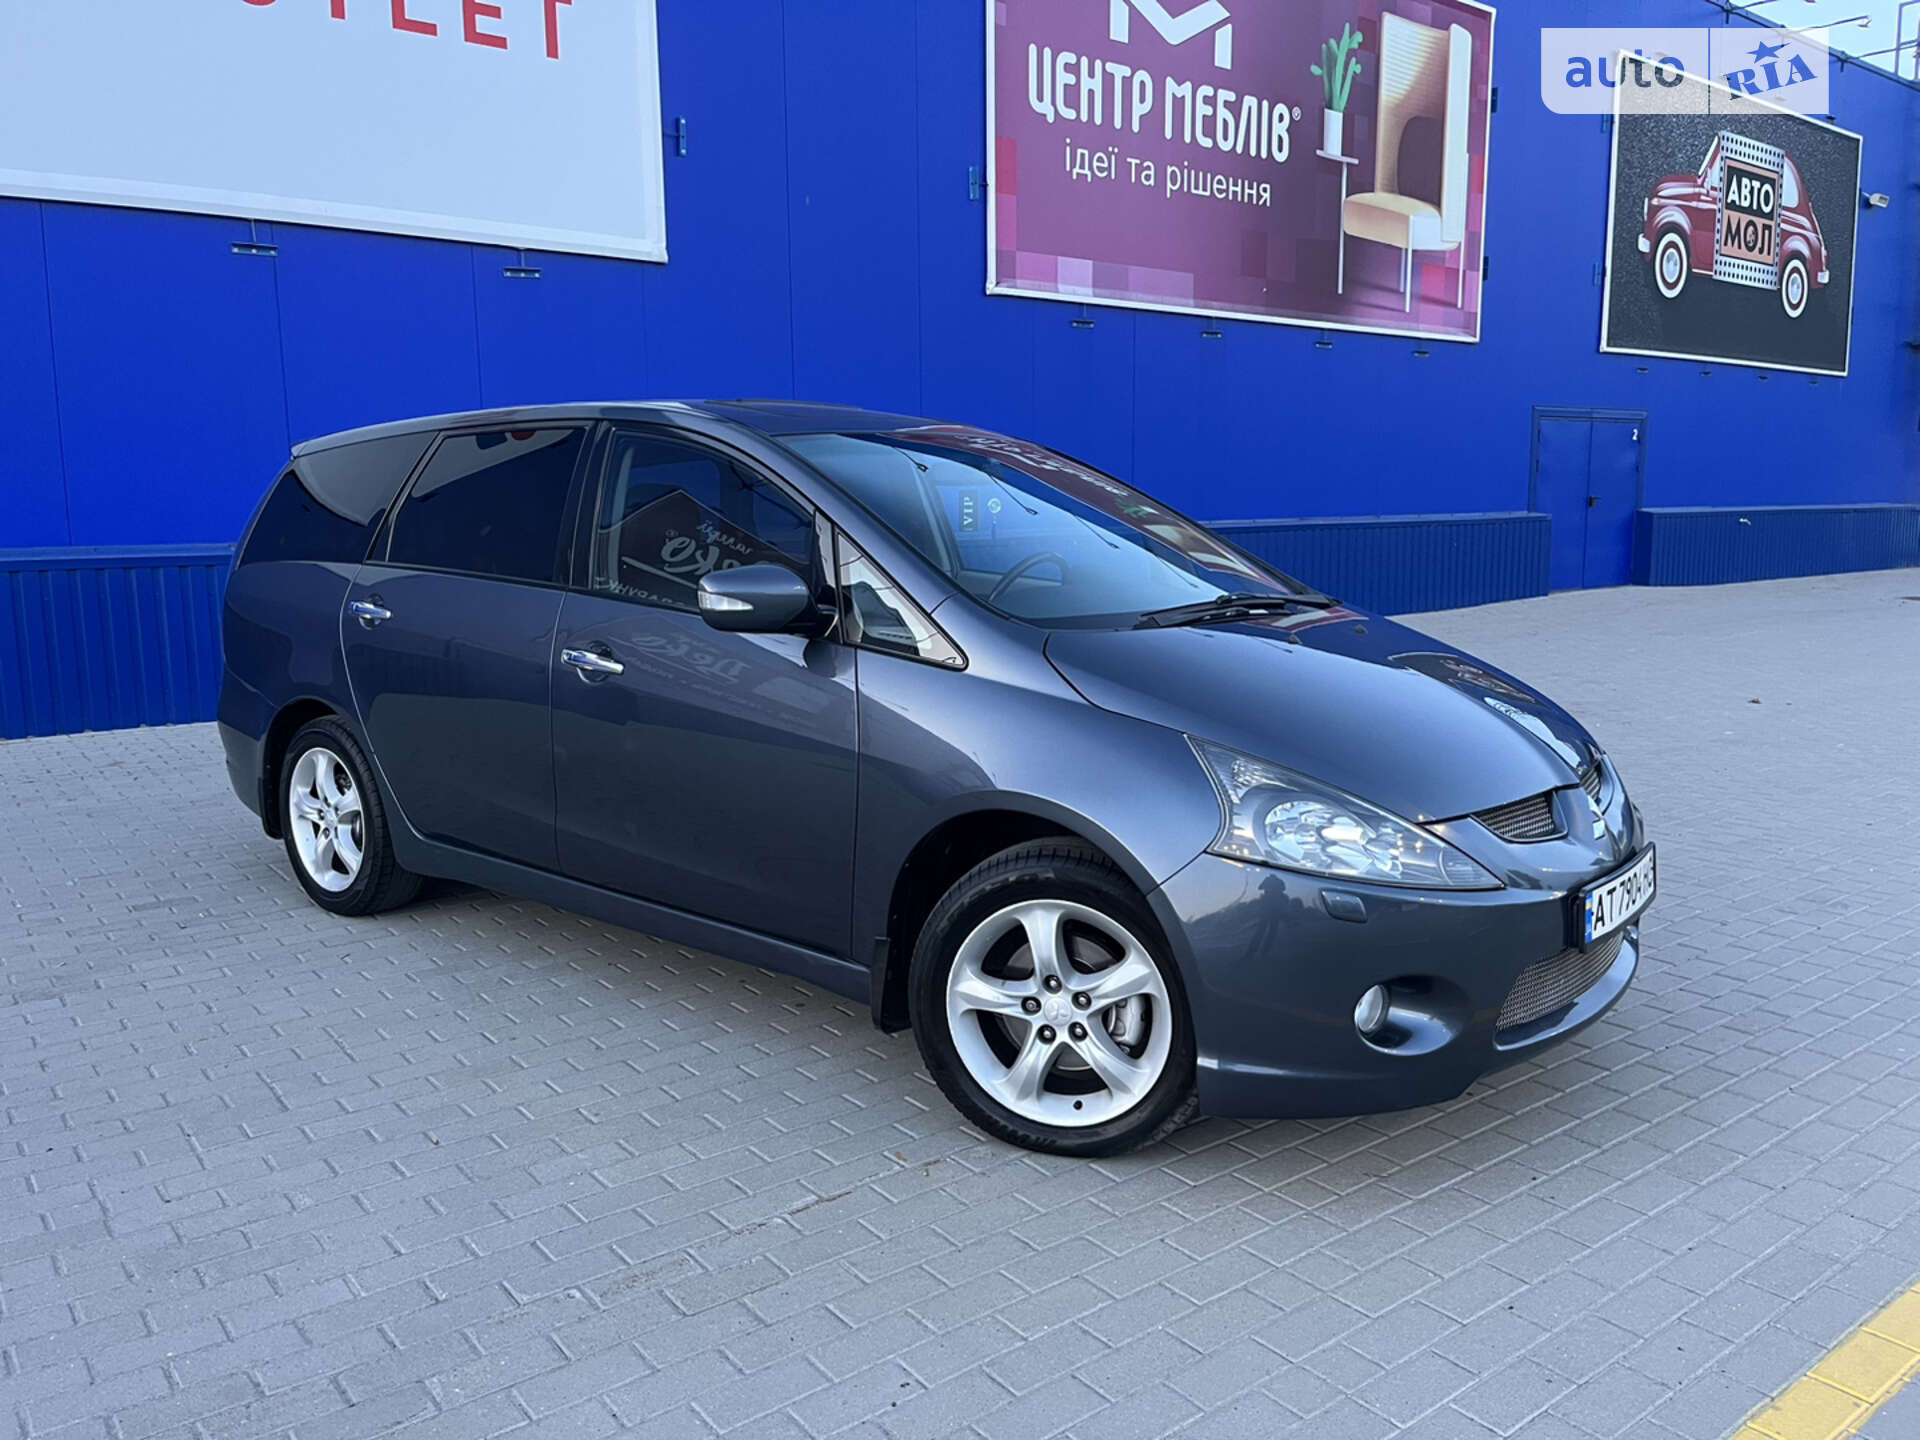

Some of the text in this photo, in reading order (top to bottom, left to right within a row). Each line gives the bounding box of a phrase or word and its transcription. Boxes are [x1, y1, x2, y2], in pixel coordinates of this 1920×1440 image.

[1028, 43, 1154, 134] ЦЕНТР
[1064, 138, 1271, 208] ідеї та рішення
[1726, 173, 1774, 214] АВТО
[1723, 217, 1772, 256] МОЛ
[963, 496, 975, 526] VIP
